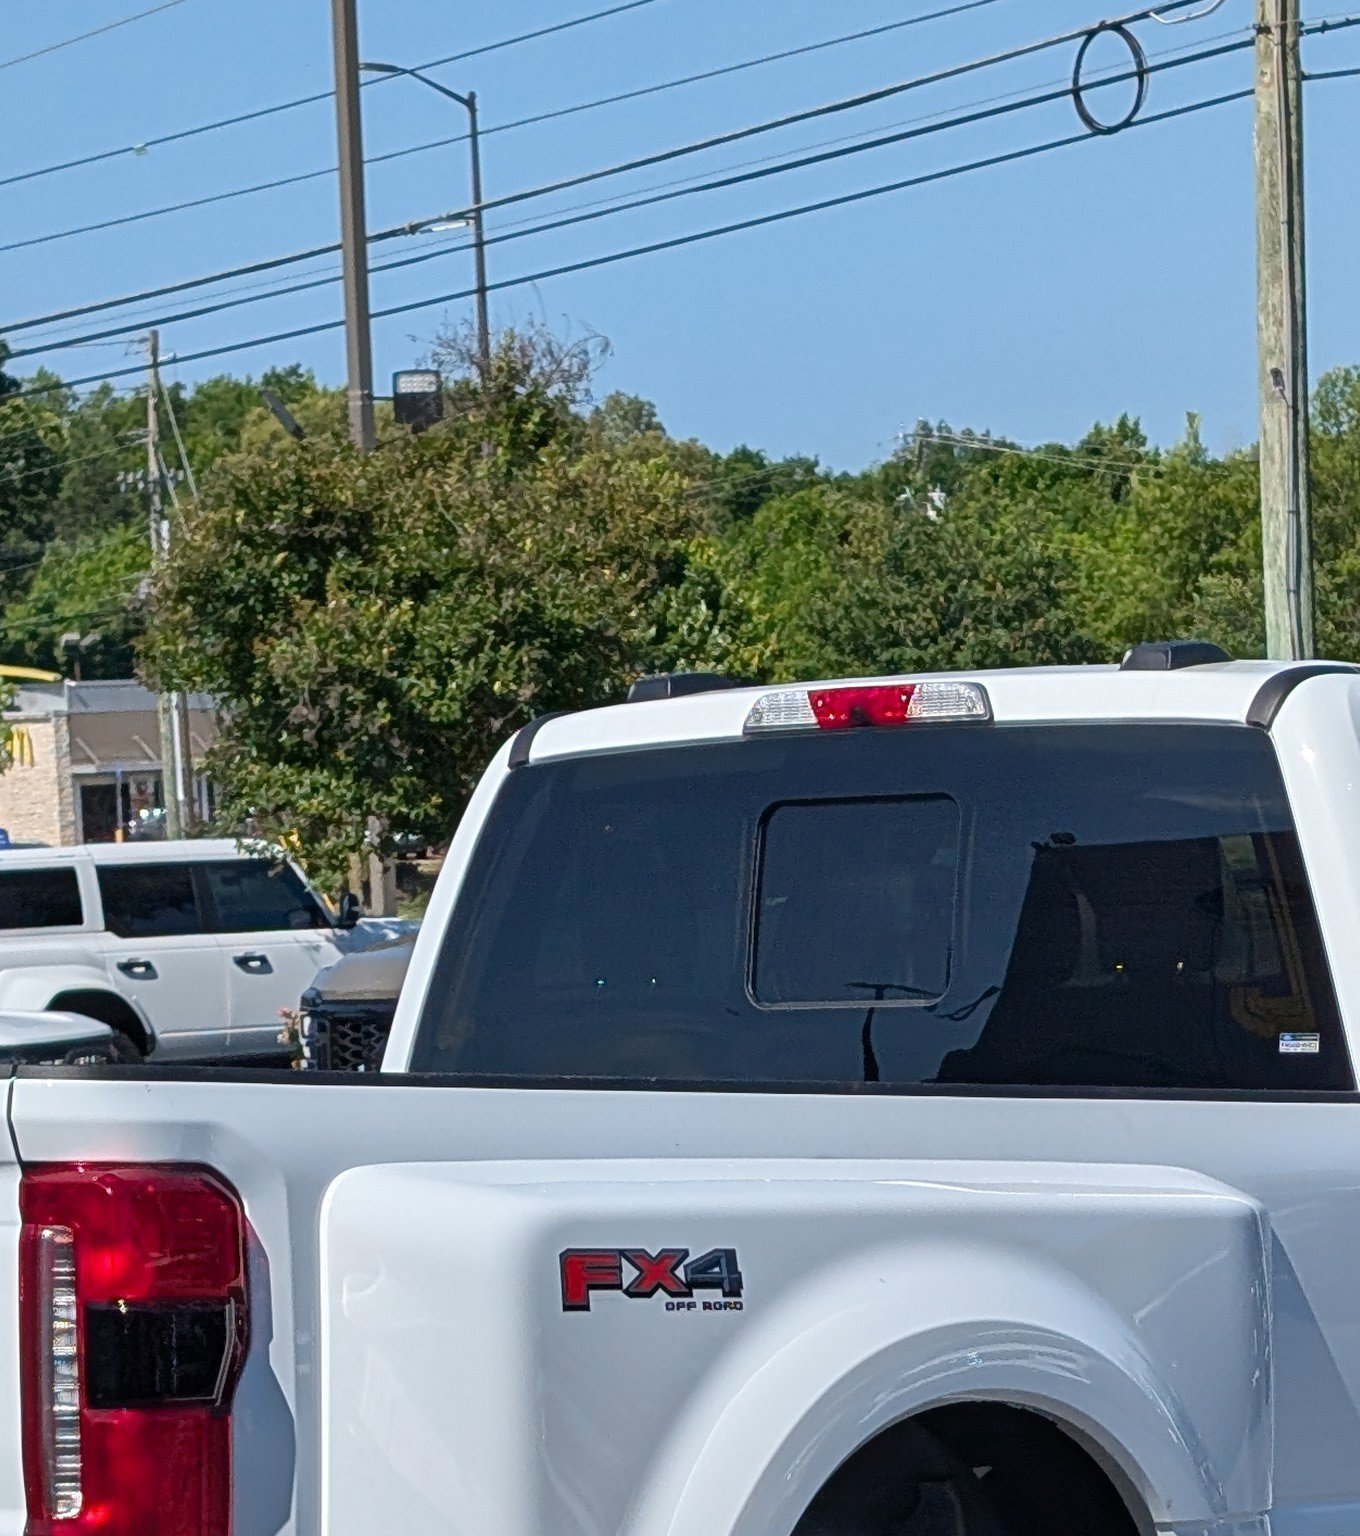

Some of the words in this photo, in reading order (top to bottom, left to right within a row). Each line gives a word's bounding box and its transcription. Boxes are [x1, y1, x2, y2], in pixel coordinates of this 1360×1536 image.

[559, 1248, 744, 1312] FX4
[665, 1301, 697, 1311] OFF
[702, 1301, 744, 1311] ROAD
